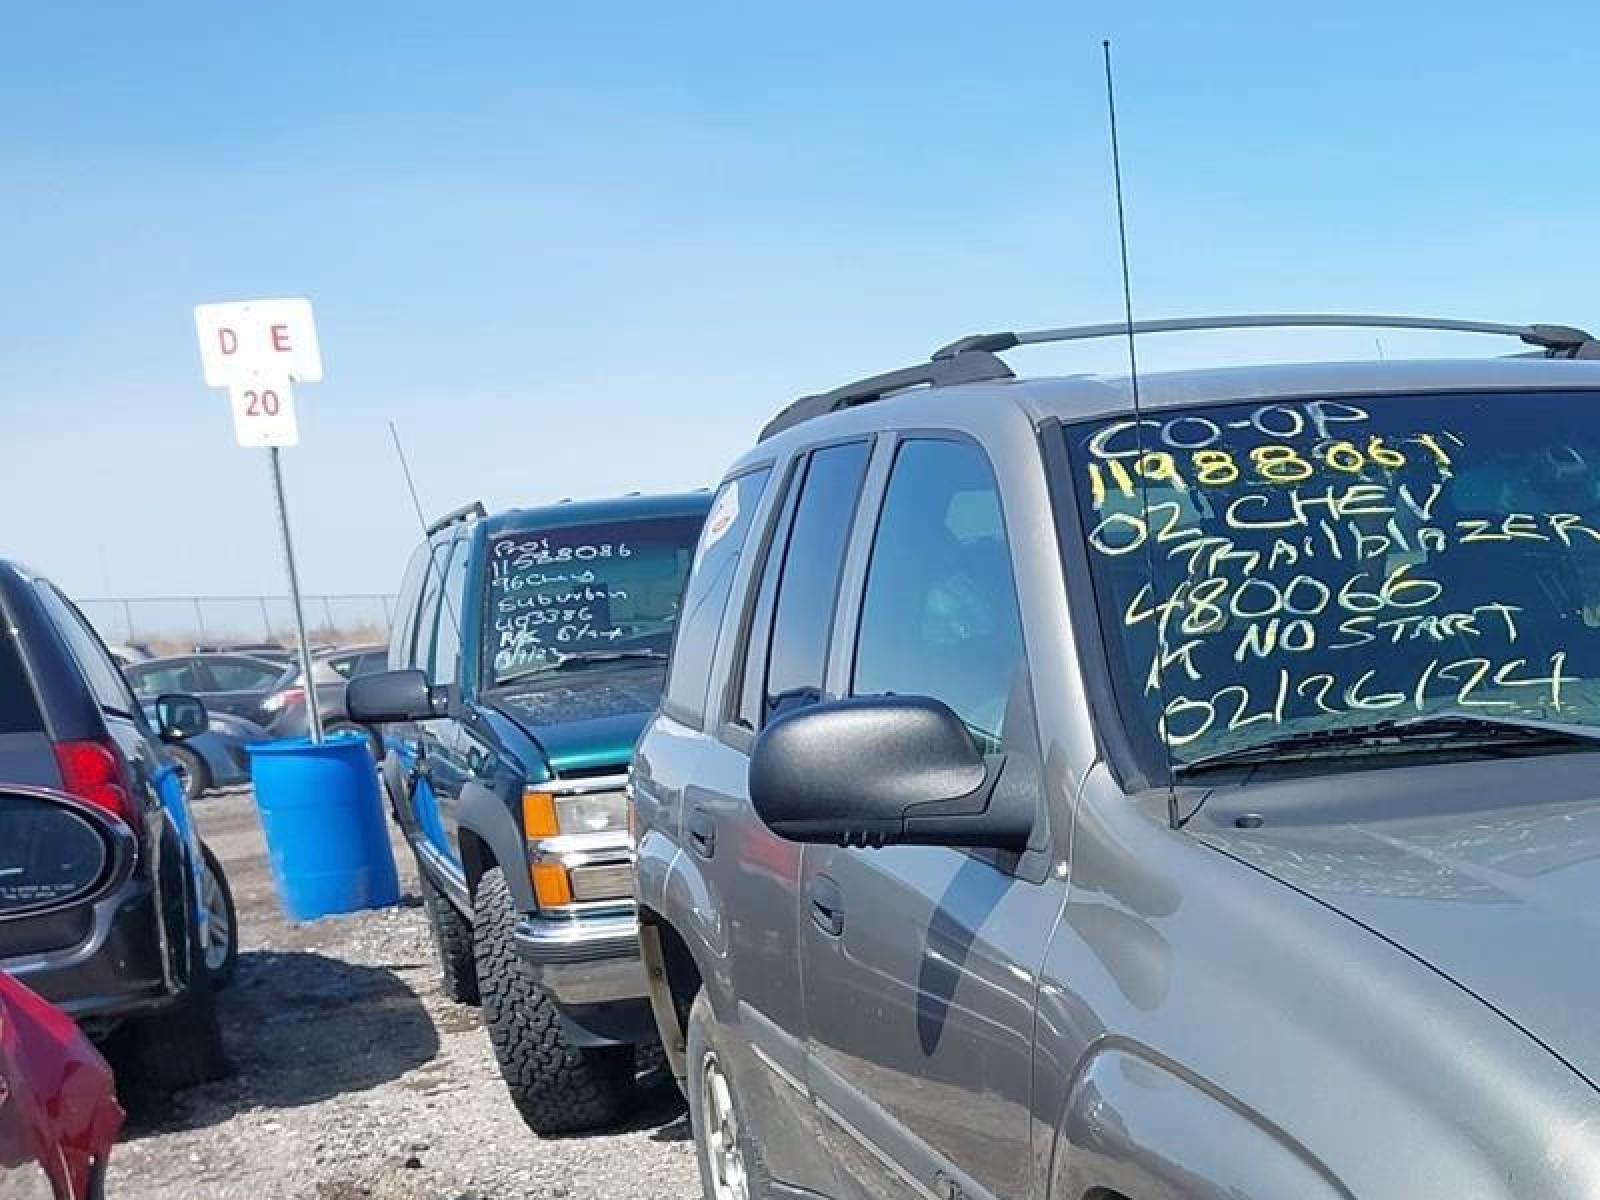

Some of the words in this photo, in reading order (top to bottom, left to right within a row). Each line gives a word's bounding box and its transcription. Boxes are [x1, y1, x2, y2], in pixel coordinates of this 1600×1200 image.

[218, 328, 237, 355] D
[271, 325, 292, 351] E
[244, 389, 280, 416] 20
[1089, 400, 1369, 458] CO-OP
[1088, 501, 1202, 556] 02
[1226, 482, 1440, 529] CHEV
[1126, 562, 1441, 650] 480066
[1234, 618, 1315, 662] NO
[1328, 602, 1522, 650] START
